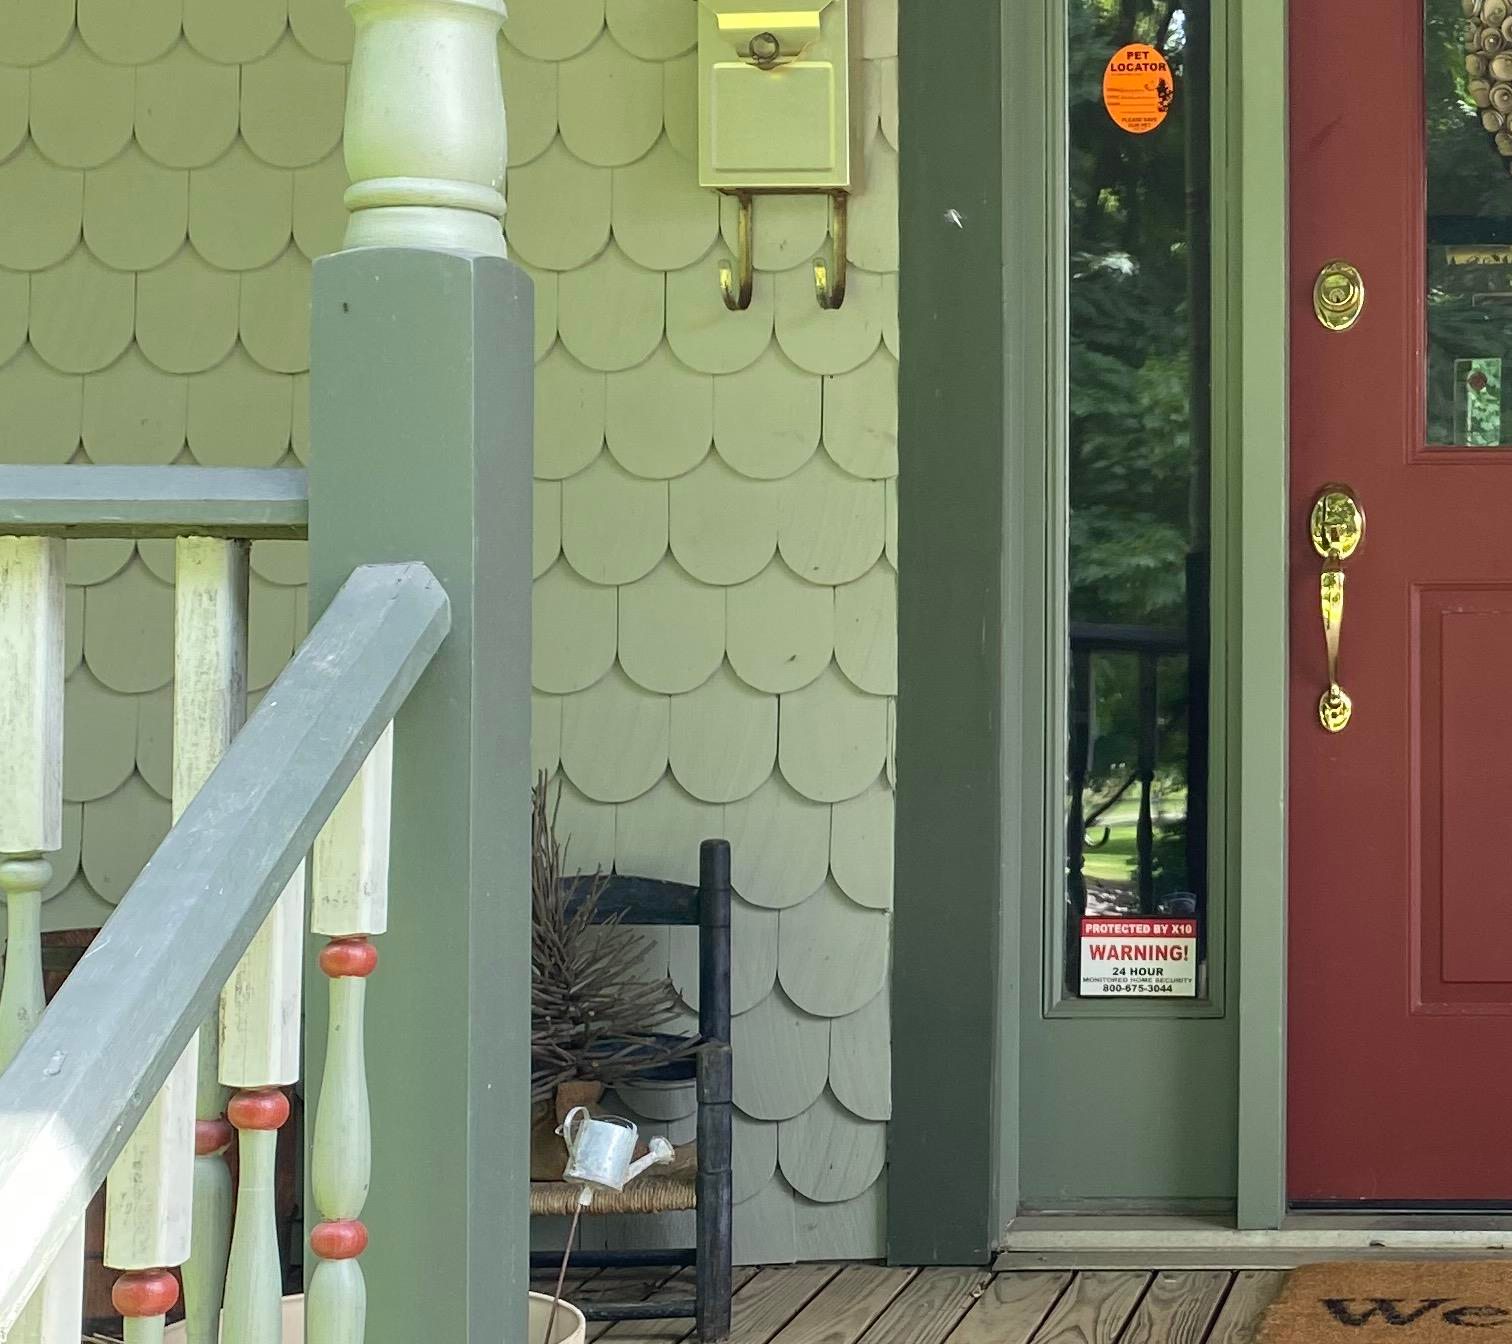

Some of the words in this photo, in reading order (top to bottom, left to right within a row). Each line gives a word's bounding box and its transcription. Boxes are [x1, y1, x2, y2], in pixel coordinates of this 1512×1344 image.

[1126, 51, 1149, 60] PET
[1110, 62, 1166, 72] LOCATOR
[1085, 923, 1151, 934] PROTECTED
[1153, 923, 1168, 934] BY
[1171, 923, 1192, 934] X10
[1089, 944, 1188, 961] WARNING!
[1112, 967, 1126, 976] 24
[1129, 967, 1164, 976] HOUR
[1102, 984, 1173, 993] 800-675-3044
